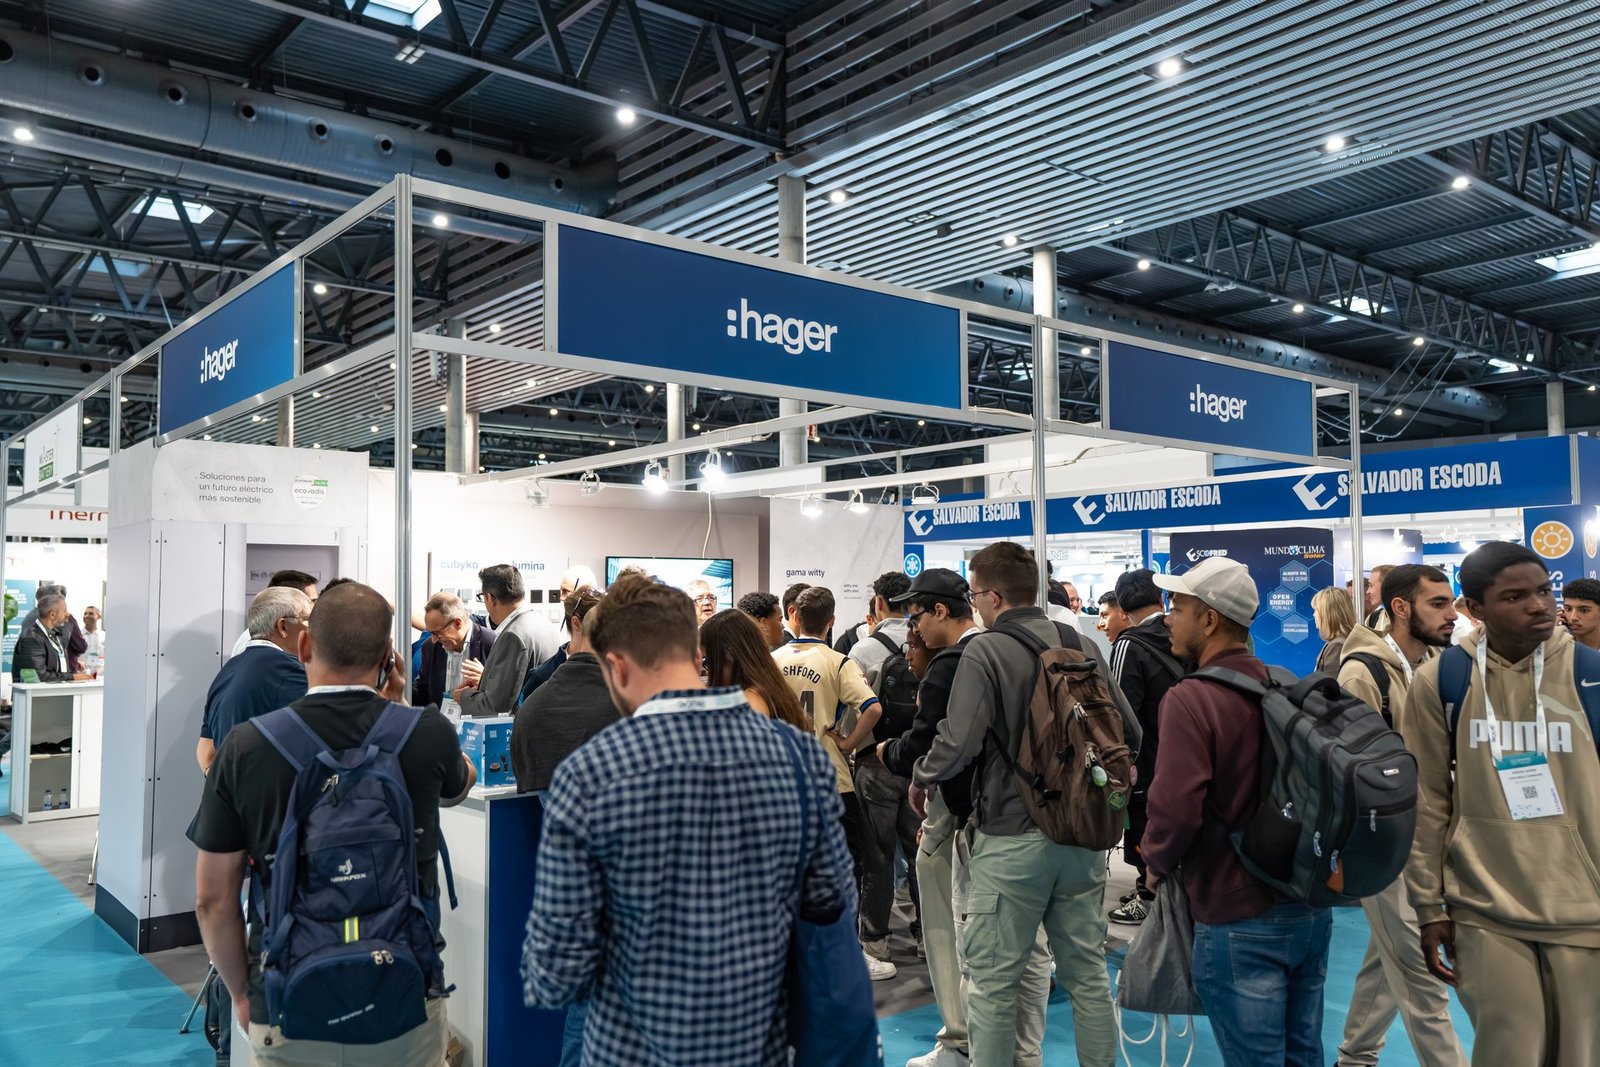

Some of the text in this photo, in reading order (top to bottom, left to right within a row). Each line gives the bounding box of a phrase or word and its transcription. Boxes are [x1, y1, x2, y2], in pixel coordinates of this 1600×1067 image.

[199, 471, 266, 483] Soluciones para
[1337, 467, 1424, 497] SLVADOR
[1430, 461, 1502, 490] ESCODA
[212, 483, 237, 492] futuro
[239, 484, 274, 494] eléctrico
[199, 493, 262, 504] más sostenible
[1105, 489, 1167, 513] SALVADOR
[1170, 485, 1221, 509] ESCODA
[933, 506, 979, 526] SALVADOR
[982, 502, 1021, 523] ESCODA
[440, 560, 479, 571] cubyko
[512, 560, 545, 570] lumina
[785, 568, 825, 578] gama witty
